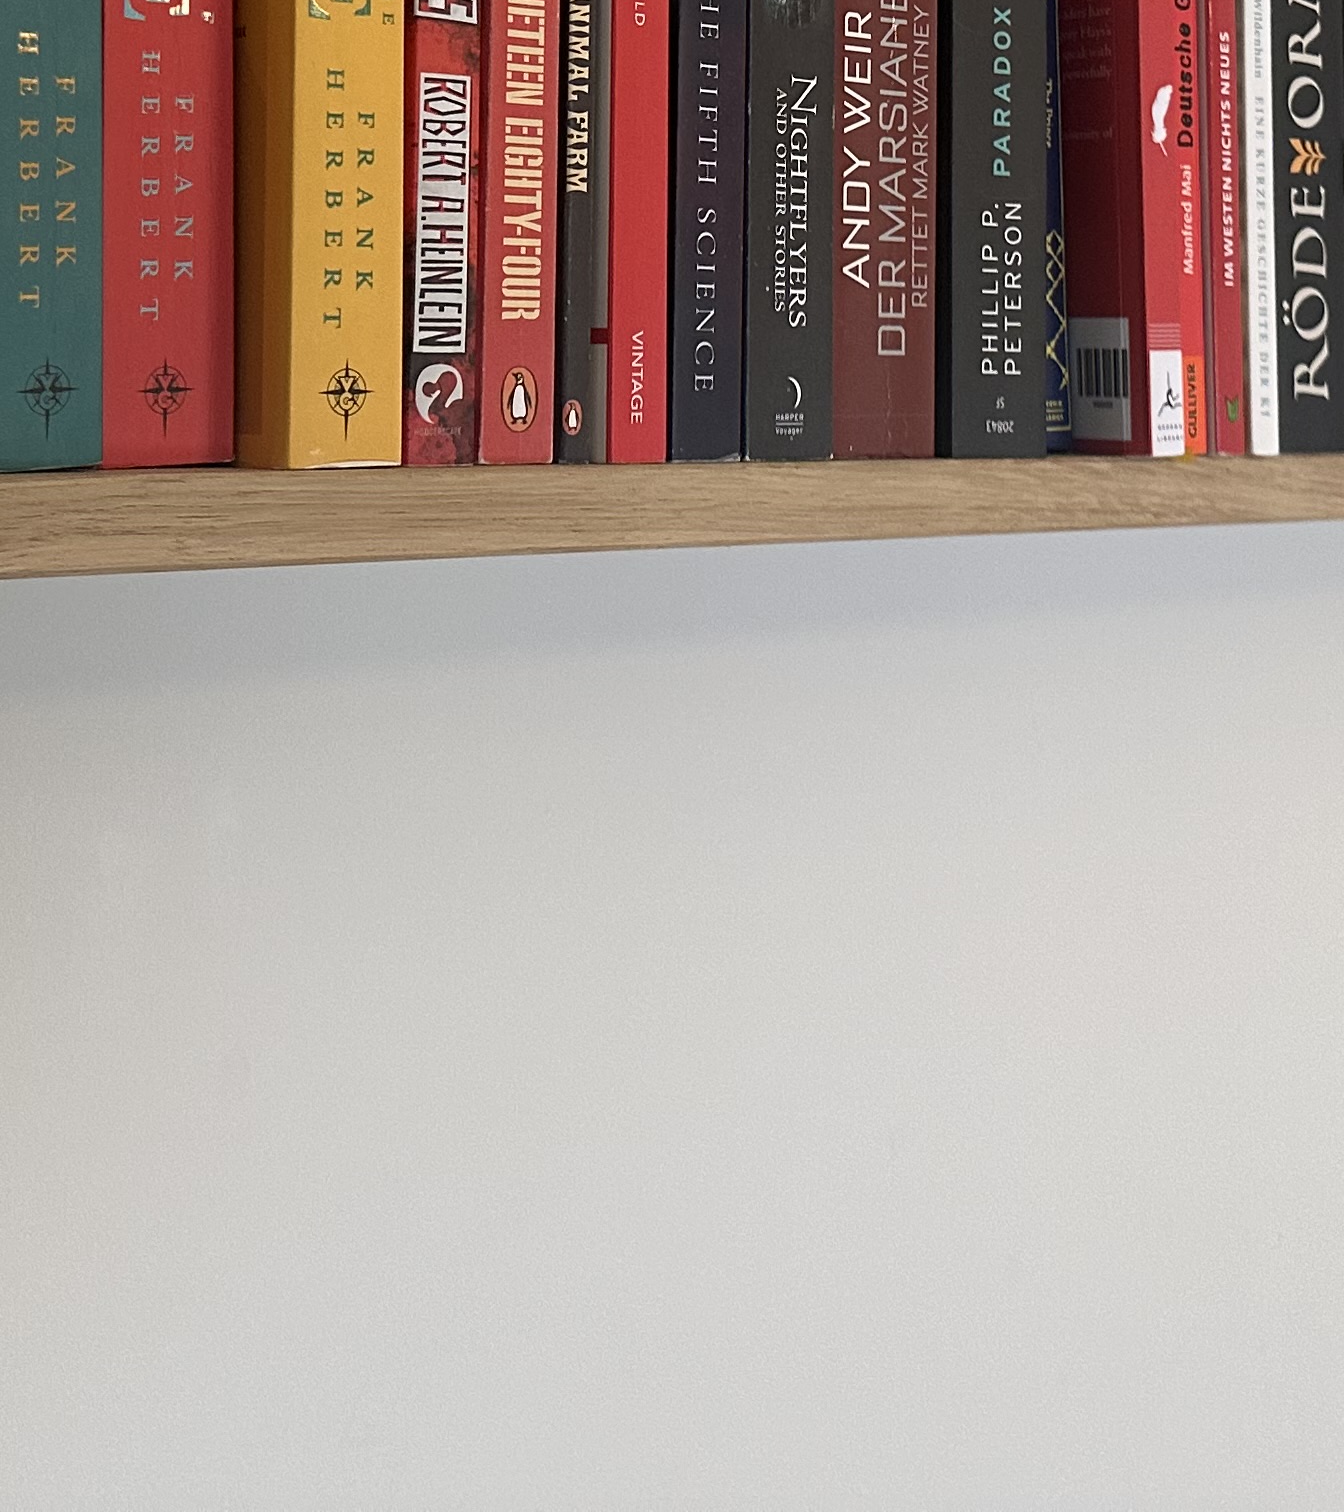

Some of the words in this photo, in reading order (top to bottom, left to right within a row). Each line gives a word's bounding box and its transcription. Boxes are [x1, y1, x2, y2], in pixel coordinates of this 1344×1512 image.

[775, 87, 788, 135] AND
[843, 10, 872, 134] WEIR
[912, 4, 931, 116] WATNEY
[993, 6, 1012, 177] PARADOX
[1174, 21, 1194, 148] Deutsche
[1219, 31, 1231, 95] NEUES
[17, 30, 40, 308] HERBERT
[54, 75, 77, 265] FRANK
[422, 77, 467, 186] ROBERT
[566, 110, 589, 193] FARM
[698, 62, 719, 185] FIFTH
[911, 122, 929, 199] MARK
[1220, 100, 1233, 171] NICHTS
[139, 49, 161, 321] HERBERT
[173, 92, 195, 281] FRANK
[323, 68, 345, 328] HERBERT
[356, 111, 376, 290] FRANK
[501, 117, 544, 321] EIGHTY-FOUR
[775, 142, 788, 217] OTHER
[788, 74, 819, 328] NIGHTFLYERS
[842, 145, 871, 288] ANDY
[981, 202, 1000, 227] P.
[1180, 164, 1193, 197] Mai
[1220, 176, 1234, 257] WESTEN
[1255, 148, 1266, 215] KURZE
[774, 224, 786, 313] STORIES
[911, 205, 928, 308] RETTET
[1004, 202, 1022, 376] PETERSON
[1180, 201, 1194, 275] Manfred
[1223, 261, 1235, 287] IM
[1257, 219, 1268, 344] GESCHICHTE
[694, 207, 717, 392] SCIENCE
[877, 259, 906, 356] DER
[981, 244, 999, 375] PHILLIP
[1282, 185, 1330, 401] RÖDE
[630, 330, 644, 425] VINTAGE
[775, 413, 804, 421] HARPER
[1186, 363, 1197, 439] GULLIVER
[1258, 352, 1269, 387] DER
